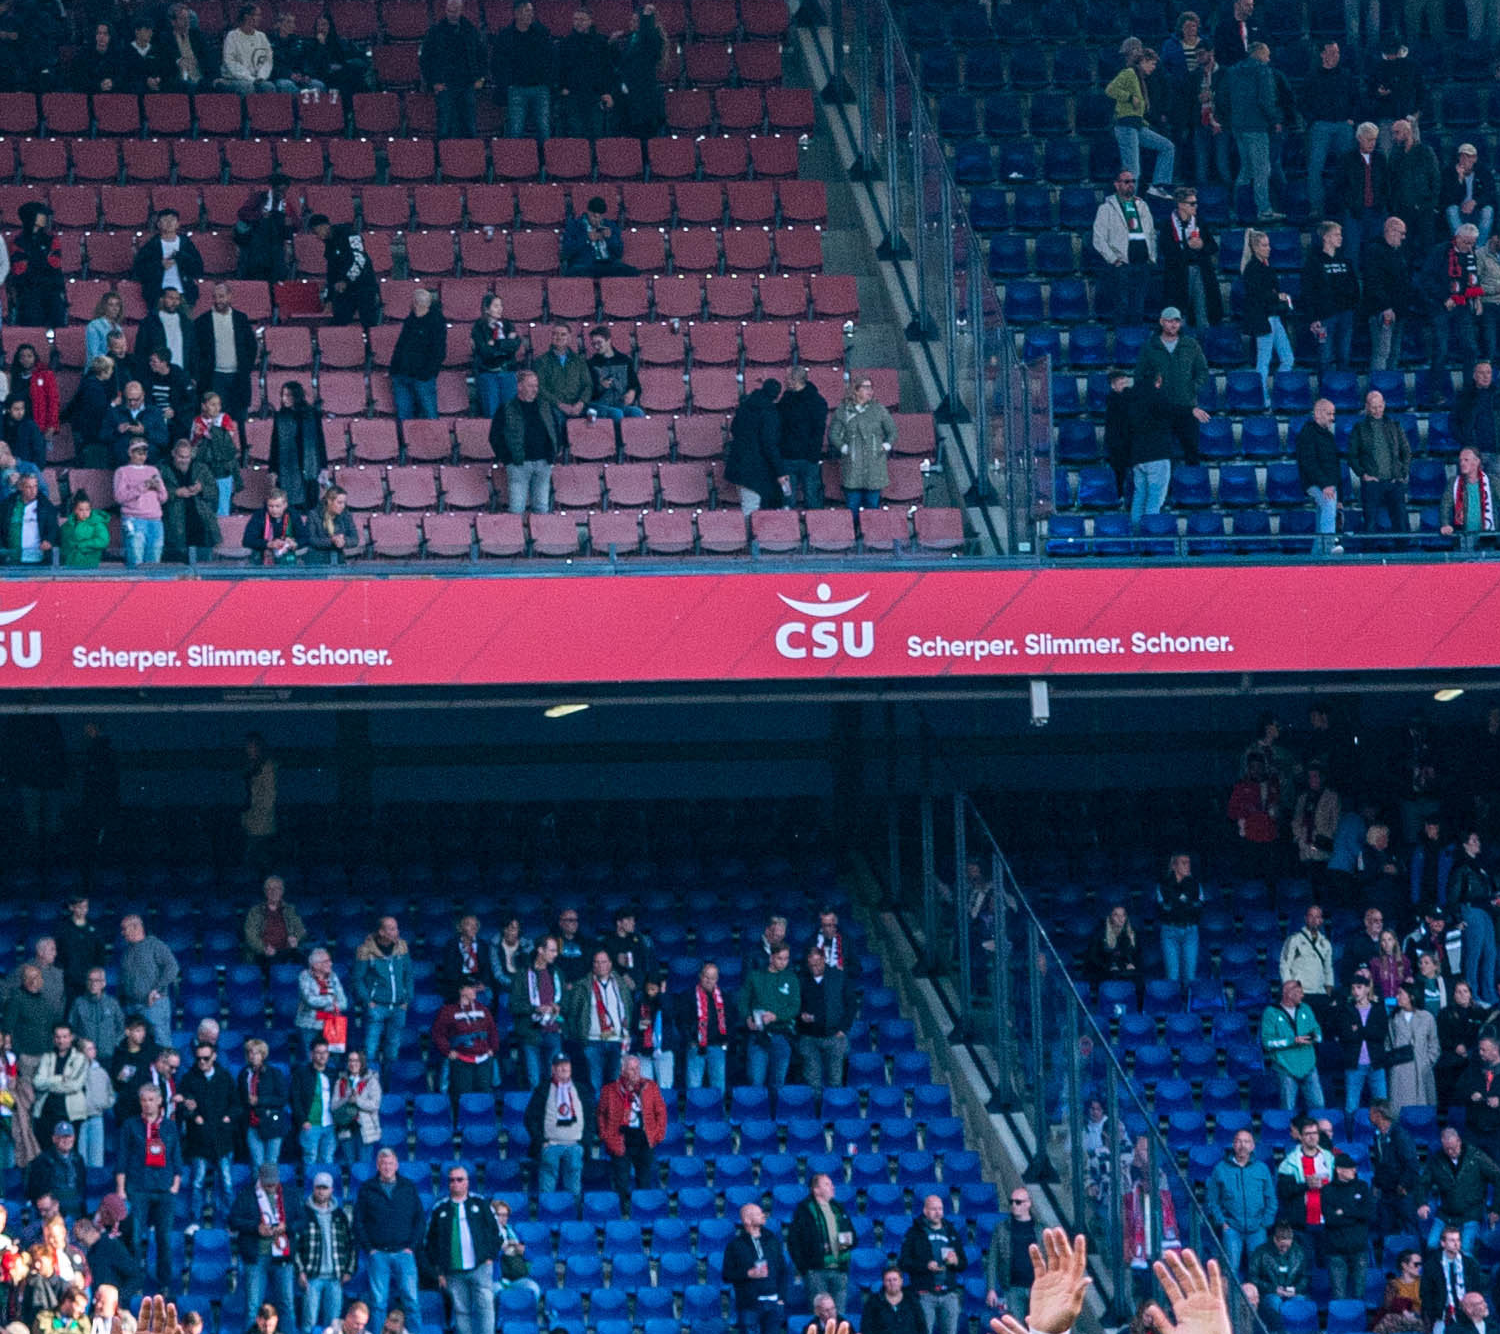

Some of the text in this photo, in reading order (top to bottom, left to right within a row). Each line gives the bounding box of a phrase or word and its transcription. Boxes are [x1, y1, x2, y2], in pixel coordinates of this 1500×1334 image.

[776, 621, 875, 659] CSU
[906, 631, 1235, 663] Scherper. Slimmer. Schoner.
[72, 644, 392, 673] Scherper. Slimmer. Schoner.
